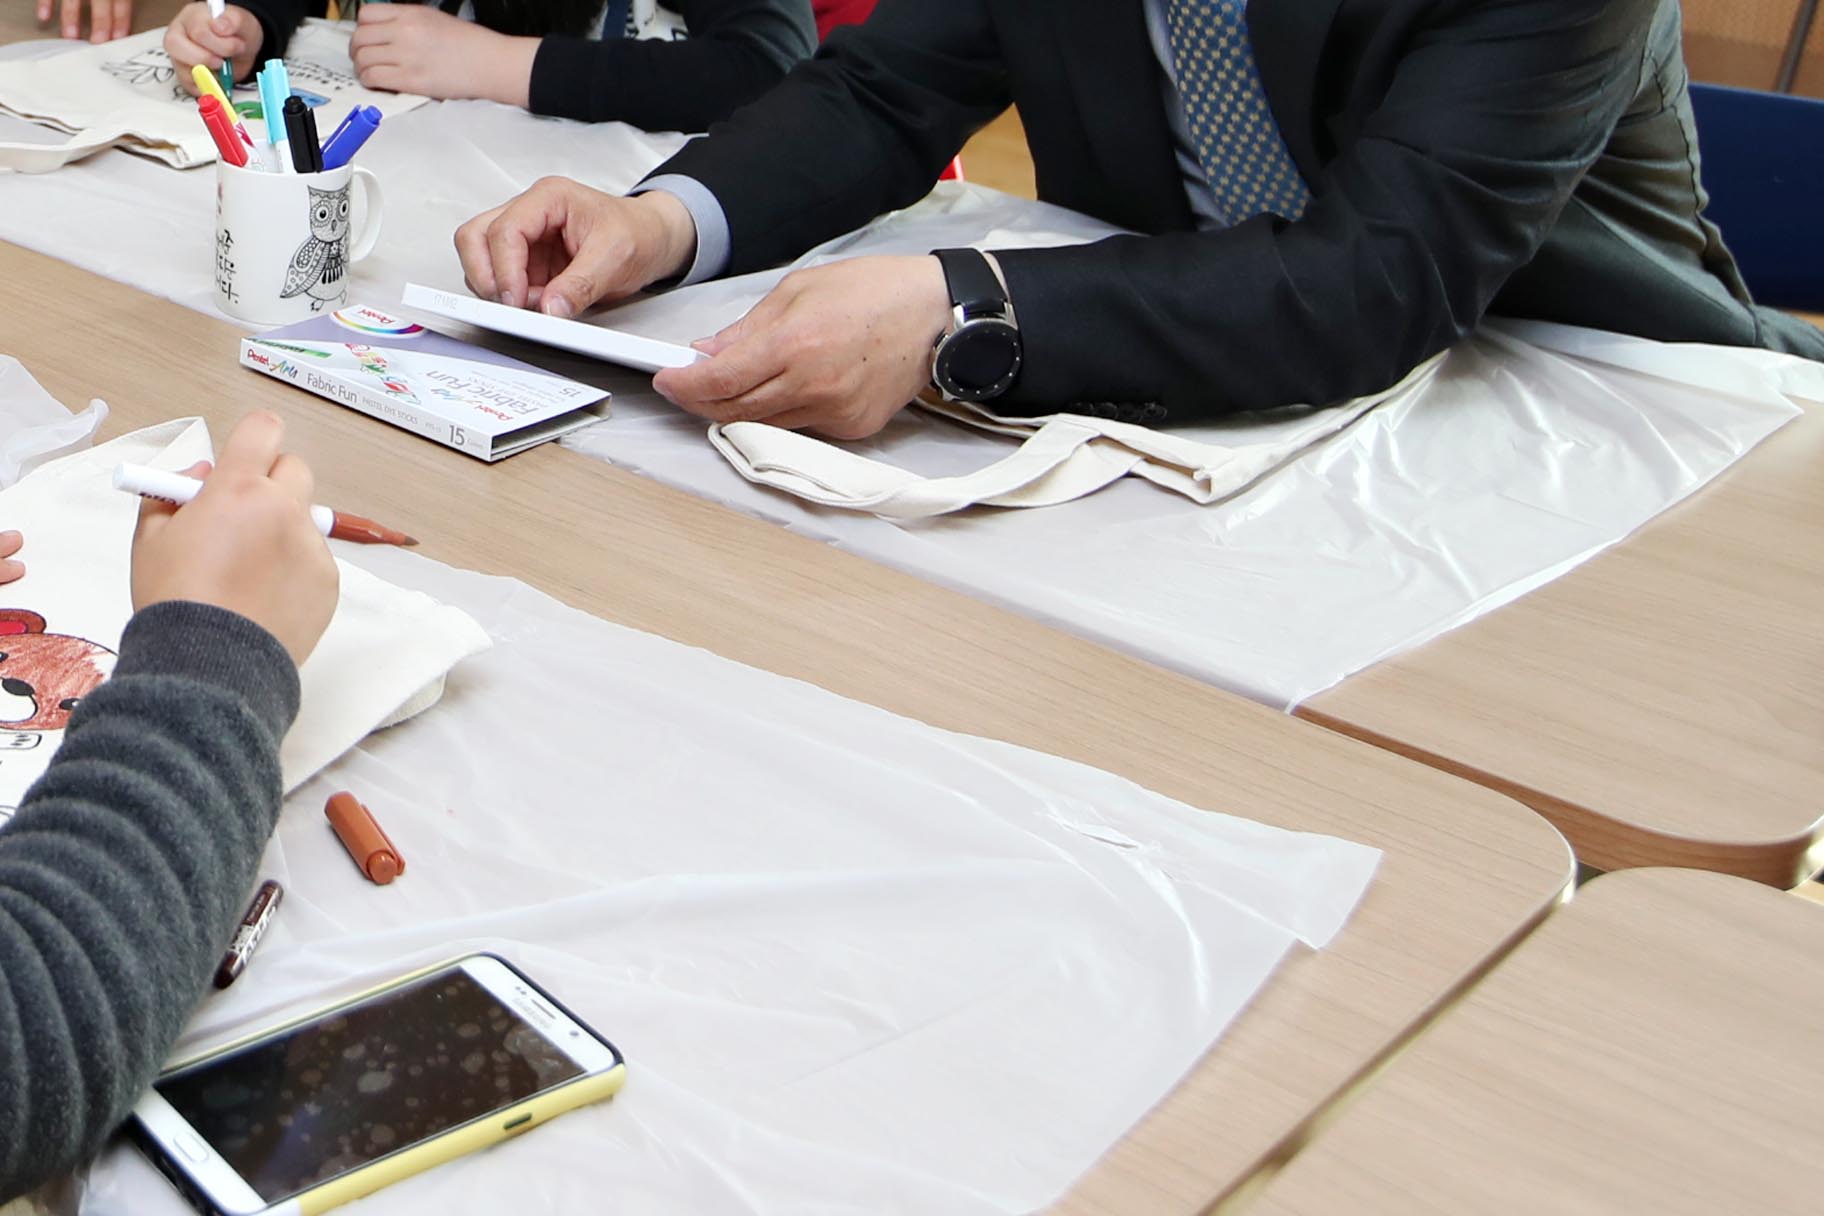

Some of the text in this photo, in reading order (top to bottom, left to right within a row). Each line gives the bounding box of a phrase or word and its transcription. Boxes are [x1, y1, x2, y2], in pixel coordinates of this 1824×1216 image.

[426, 370, 473, 390] Fun
[247, 347, 270, 367] Pentel
[307, 372, 338, 396] Fabric
[338, 384, 358, 404] Fun
[448, 424, 466, 446] 15
[468, 385, 540, 416] Fabric
